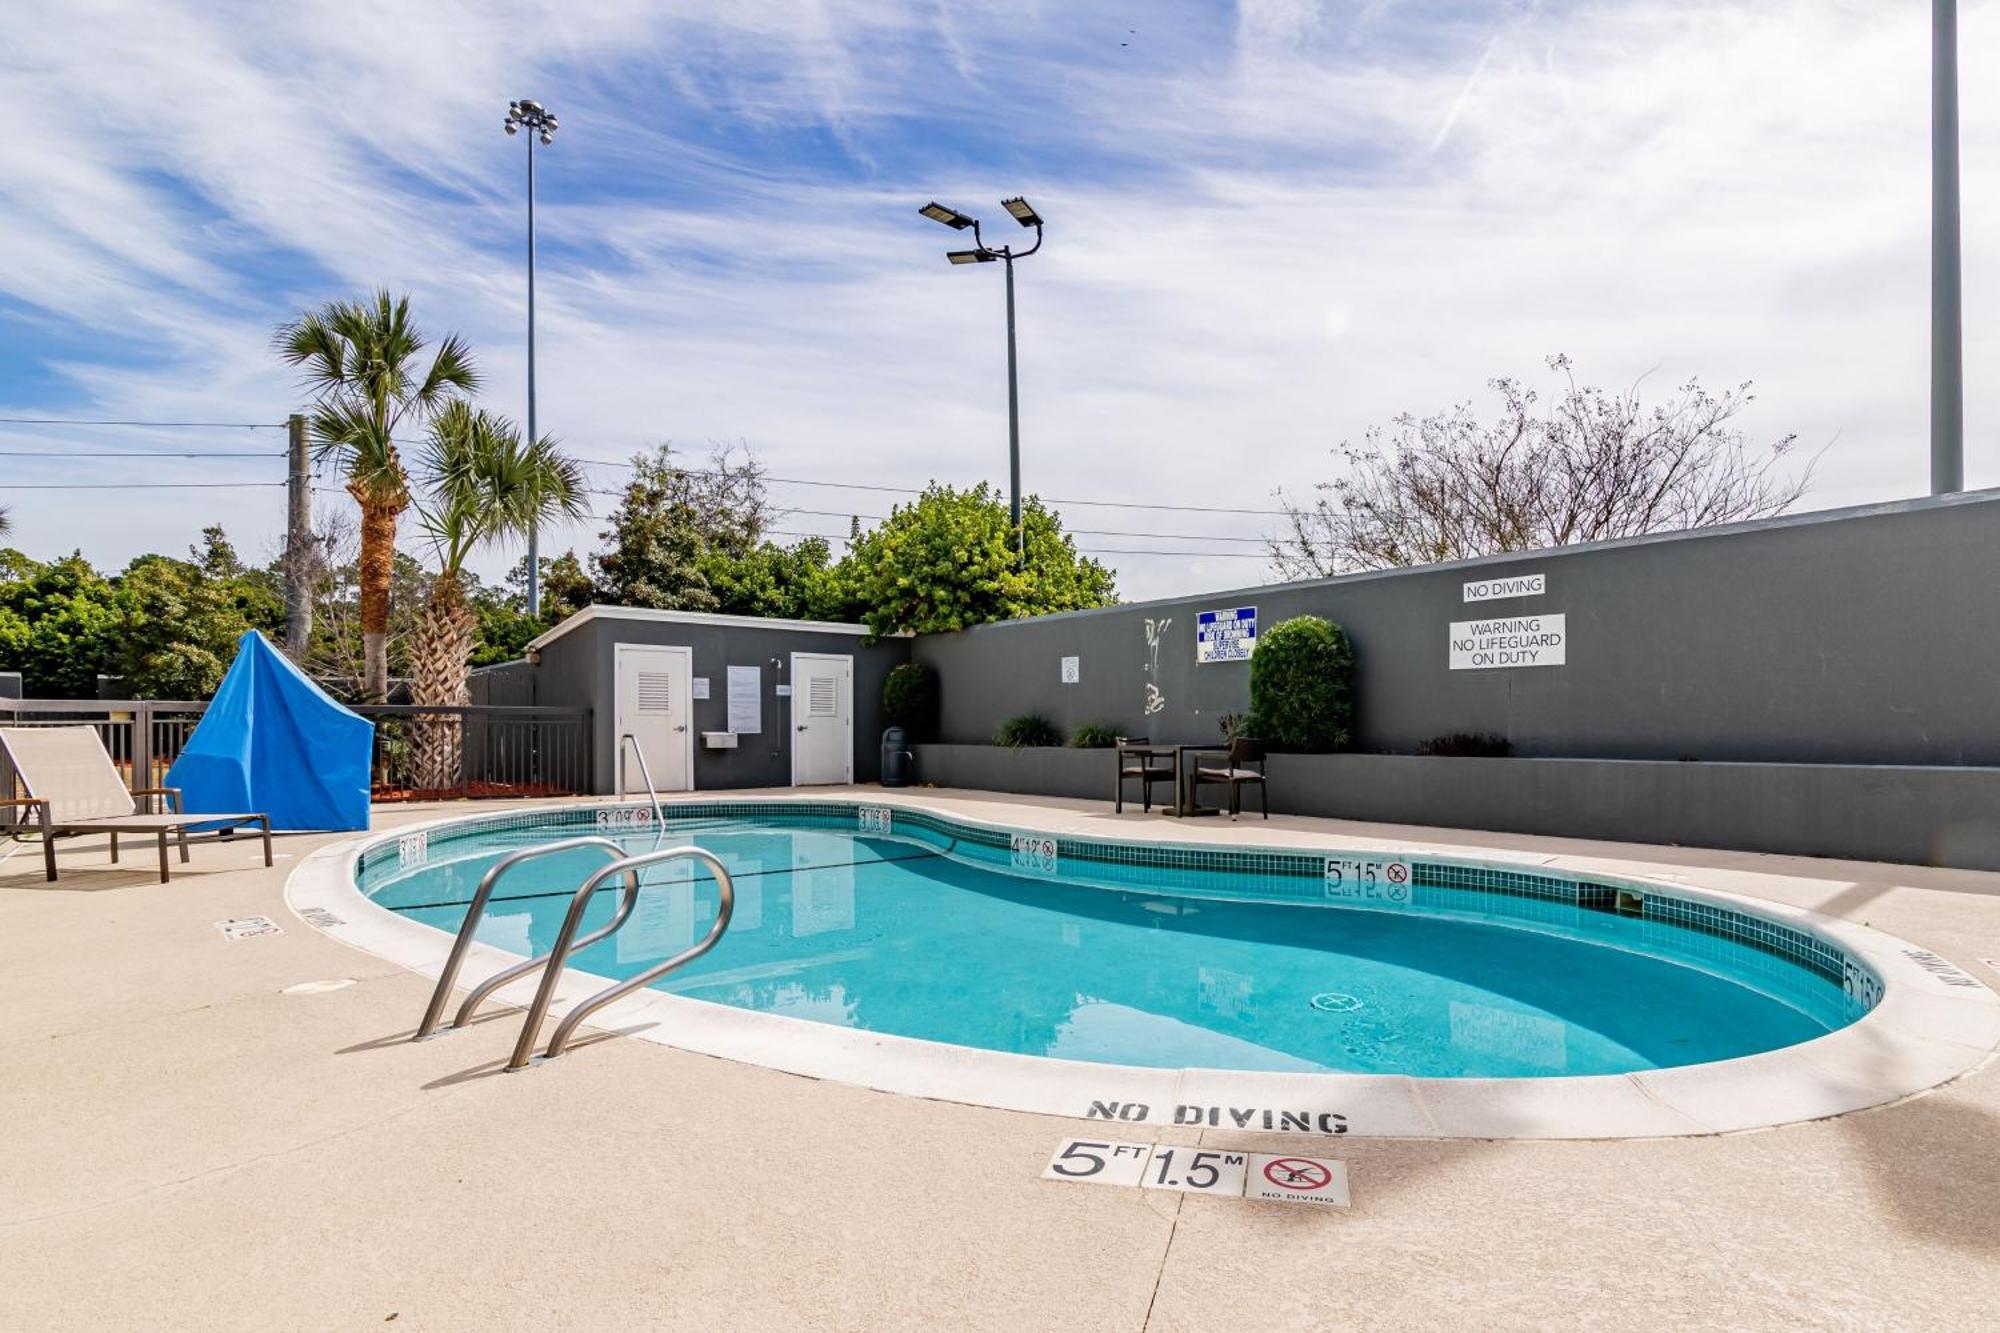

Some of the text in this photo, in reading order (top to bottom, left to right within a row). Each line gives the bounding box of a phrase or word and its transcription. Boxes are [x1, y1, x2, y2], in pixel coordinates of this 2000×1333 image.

[1467, 578, 1542, 598] NO DIVING
[1470, 619, 1541, 636] WARNING
[1453, 633, 1562, 652] NO LIFEGUARD
[1472, 650, 1540, 666] ON DUTY
[1087, 1100, 1348, 1134] NO DIVING
[1286, 1193, 1335, 1203] DIVING
